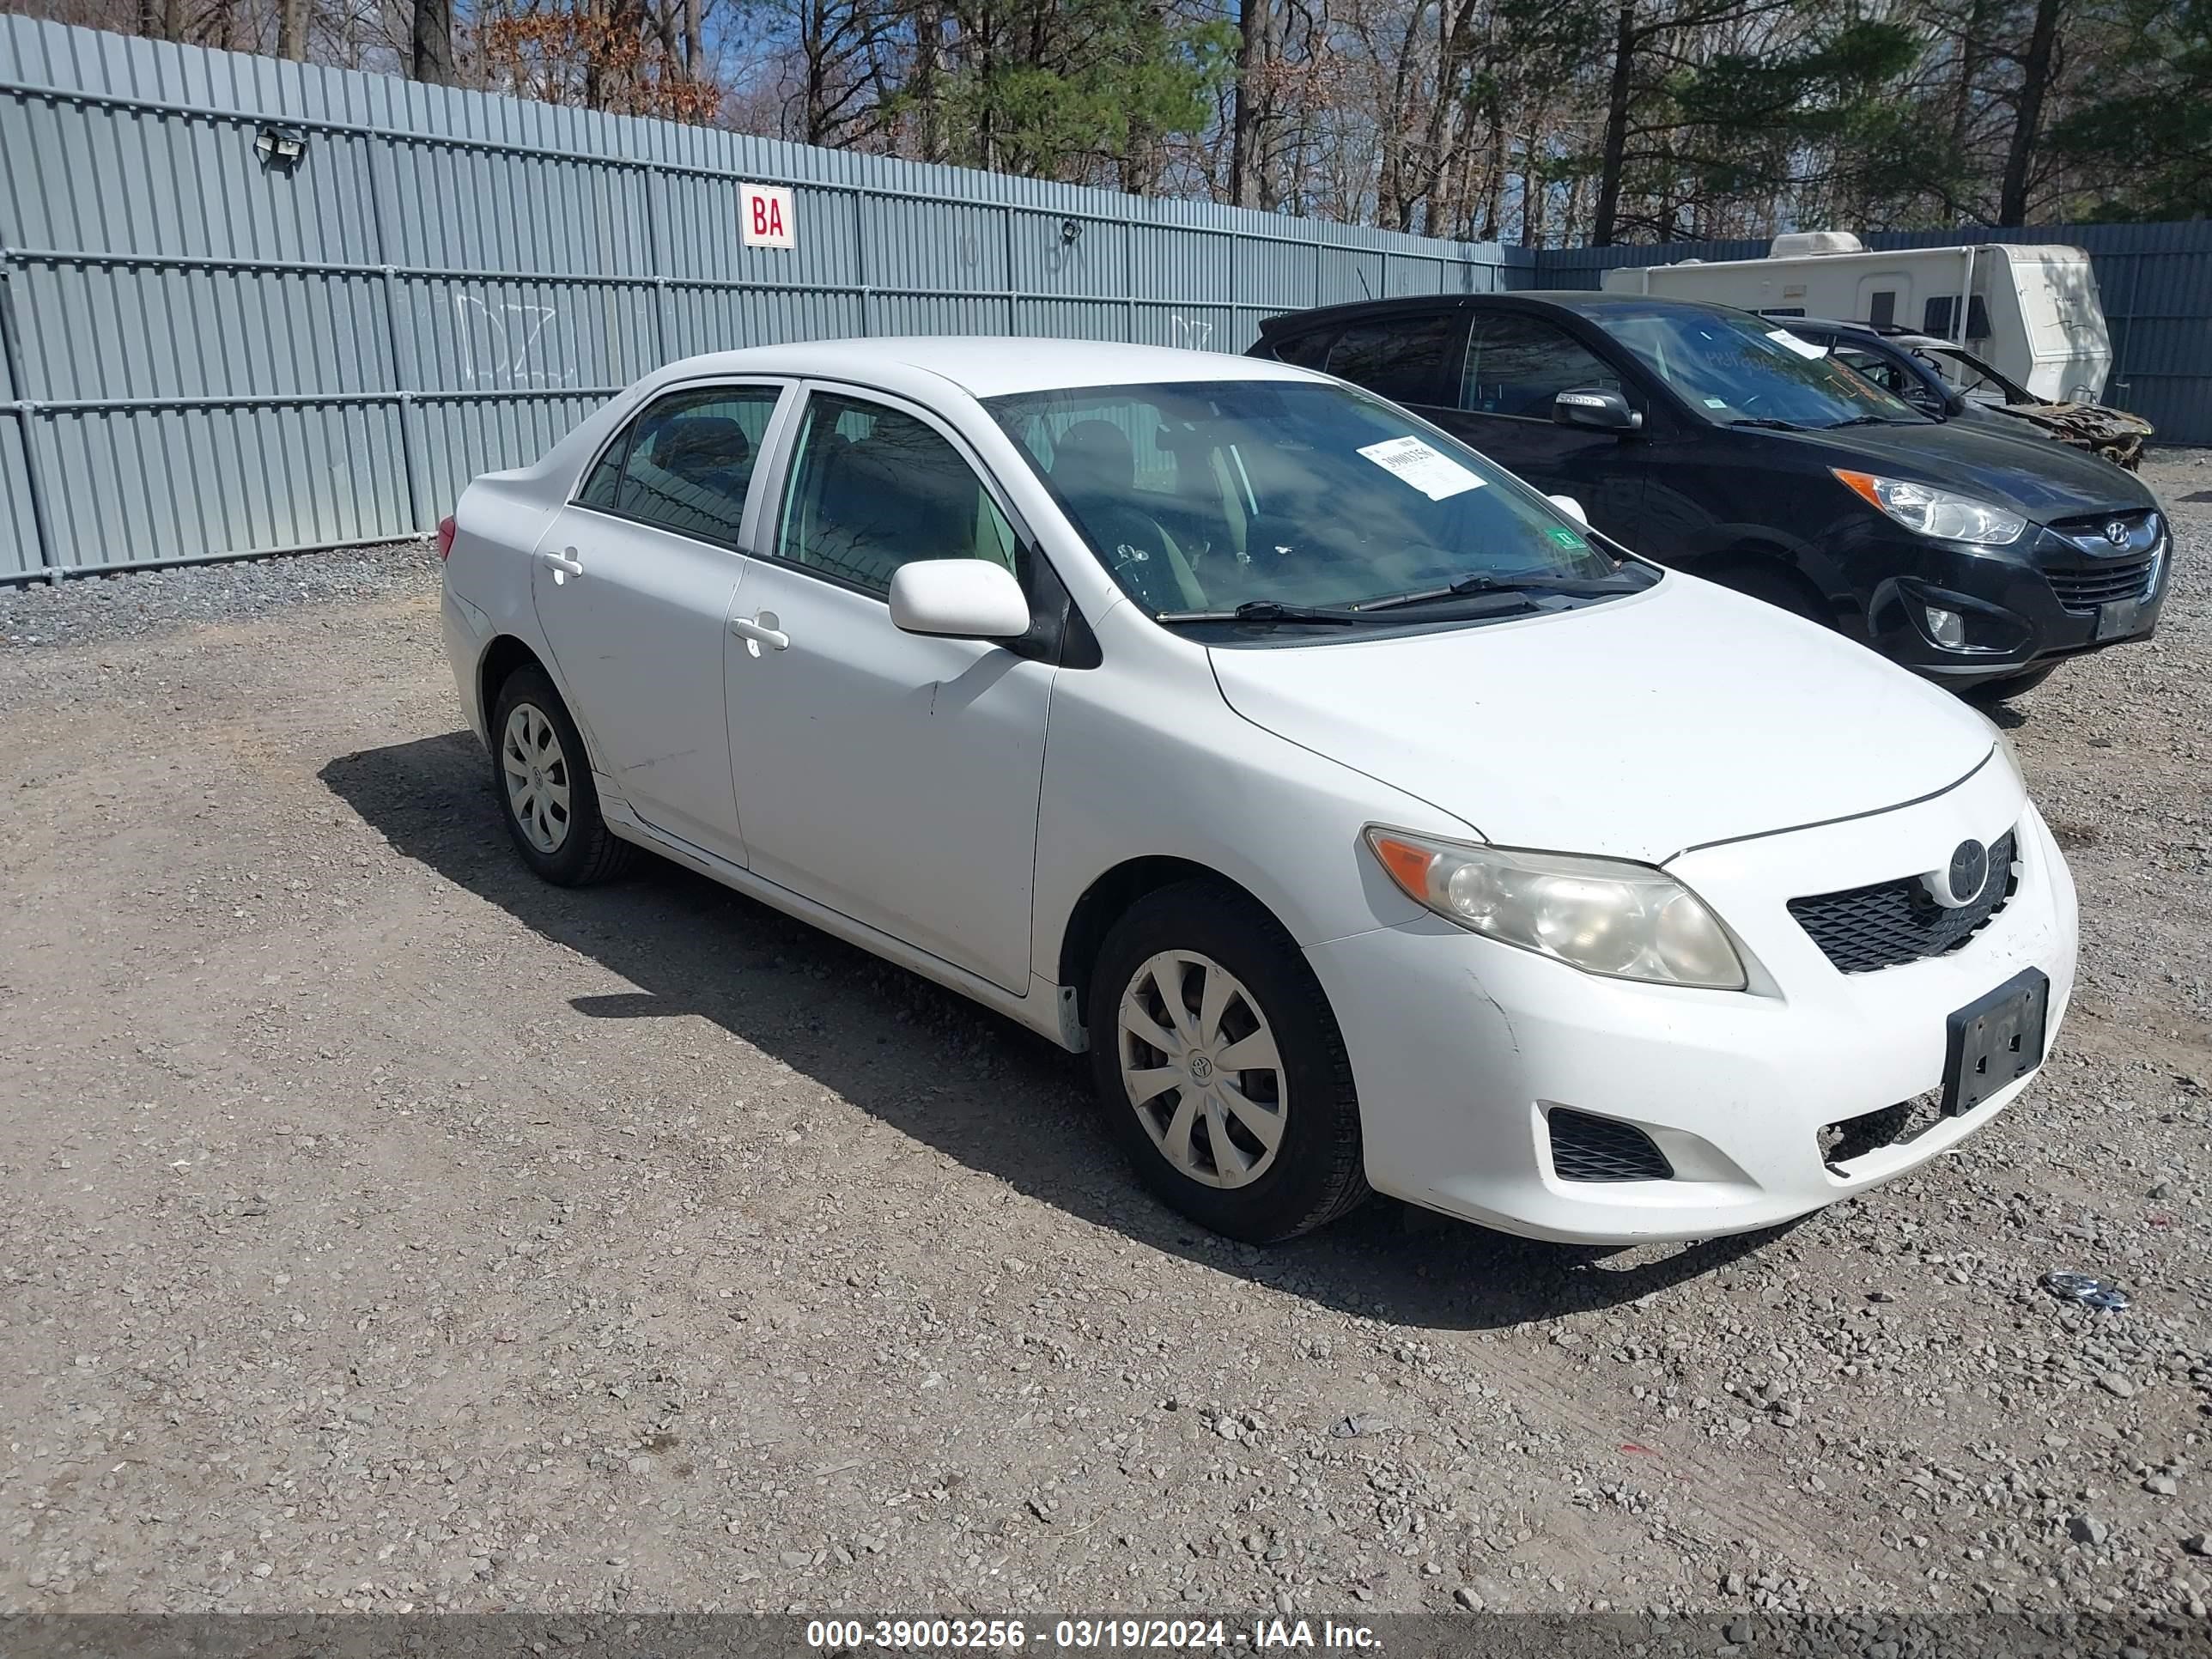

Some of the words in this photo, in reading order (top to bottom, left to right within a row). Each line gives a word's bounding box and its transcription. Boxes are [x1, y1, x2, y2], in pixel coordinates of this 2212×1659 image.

[752, 196, 783, 237] BA
[457, 293, 574, 383] DZ
[1382, 447, 1435, 468] 39003256
